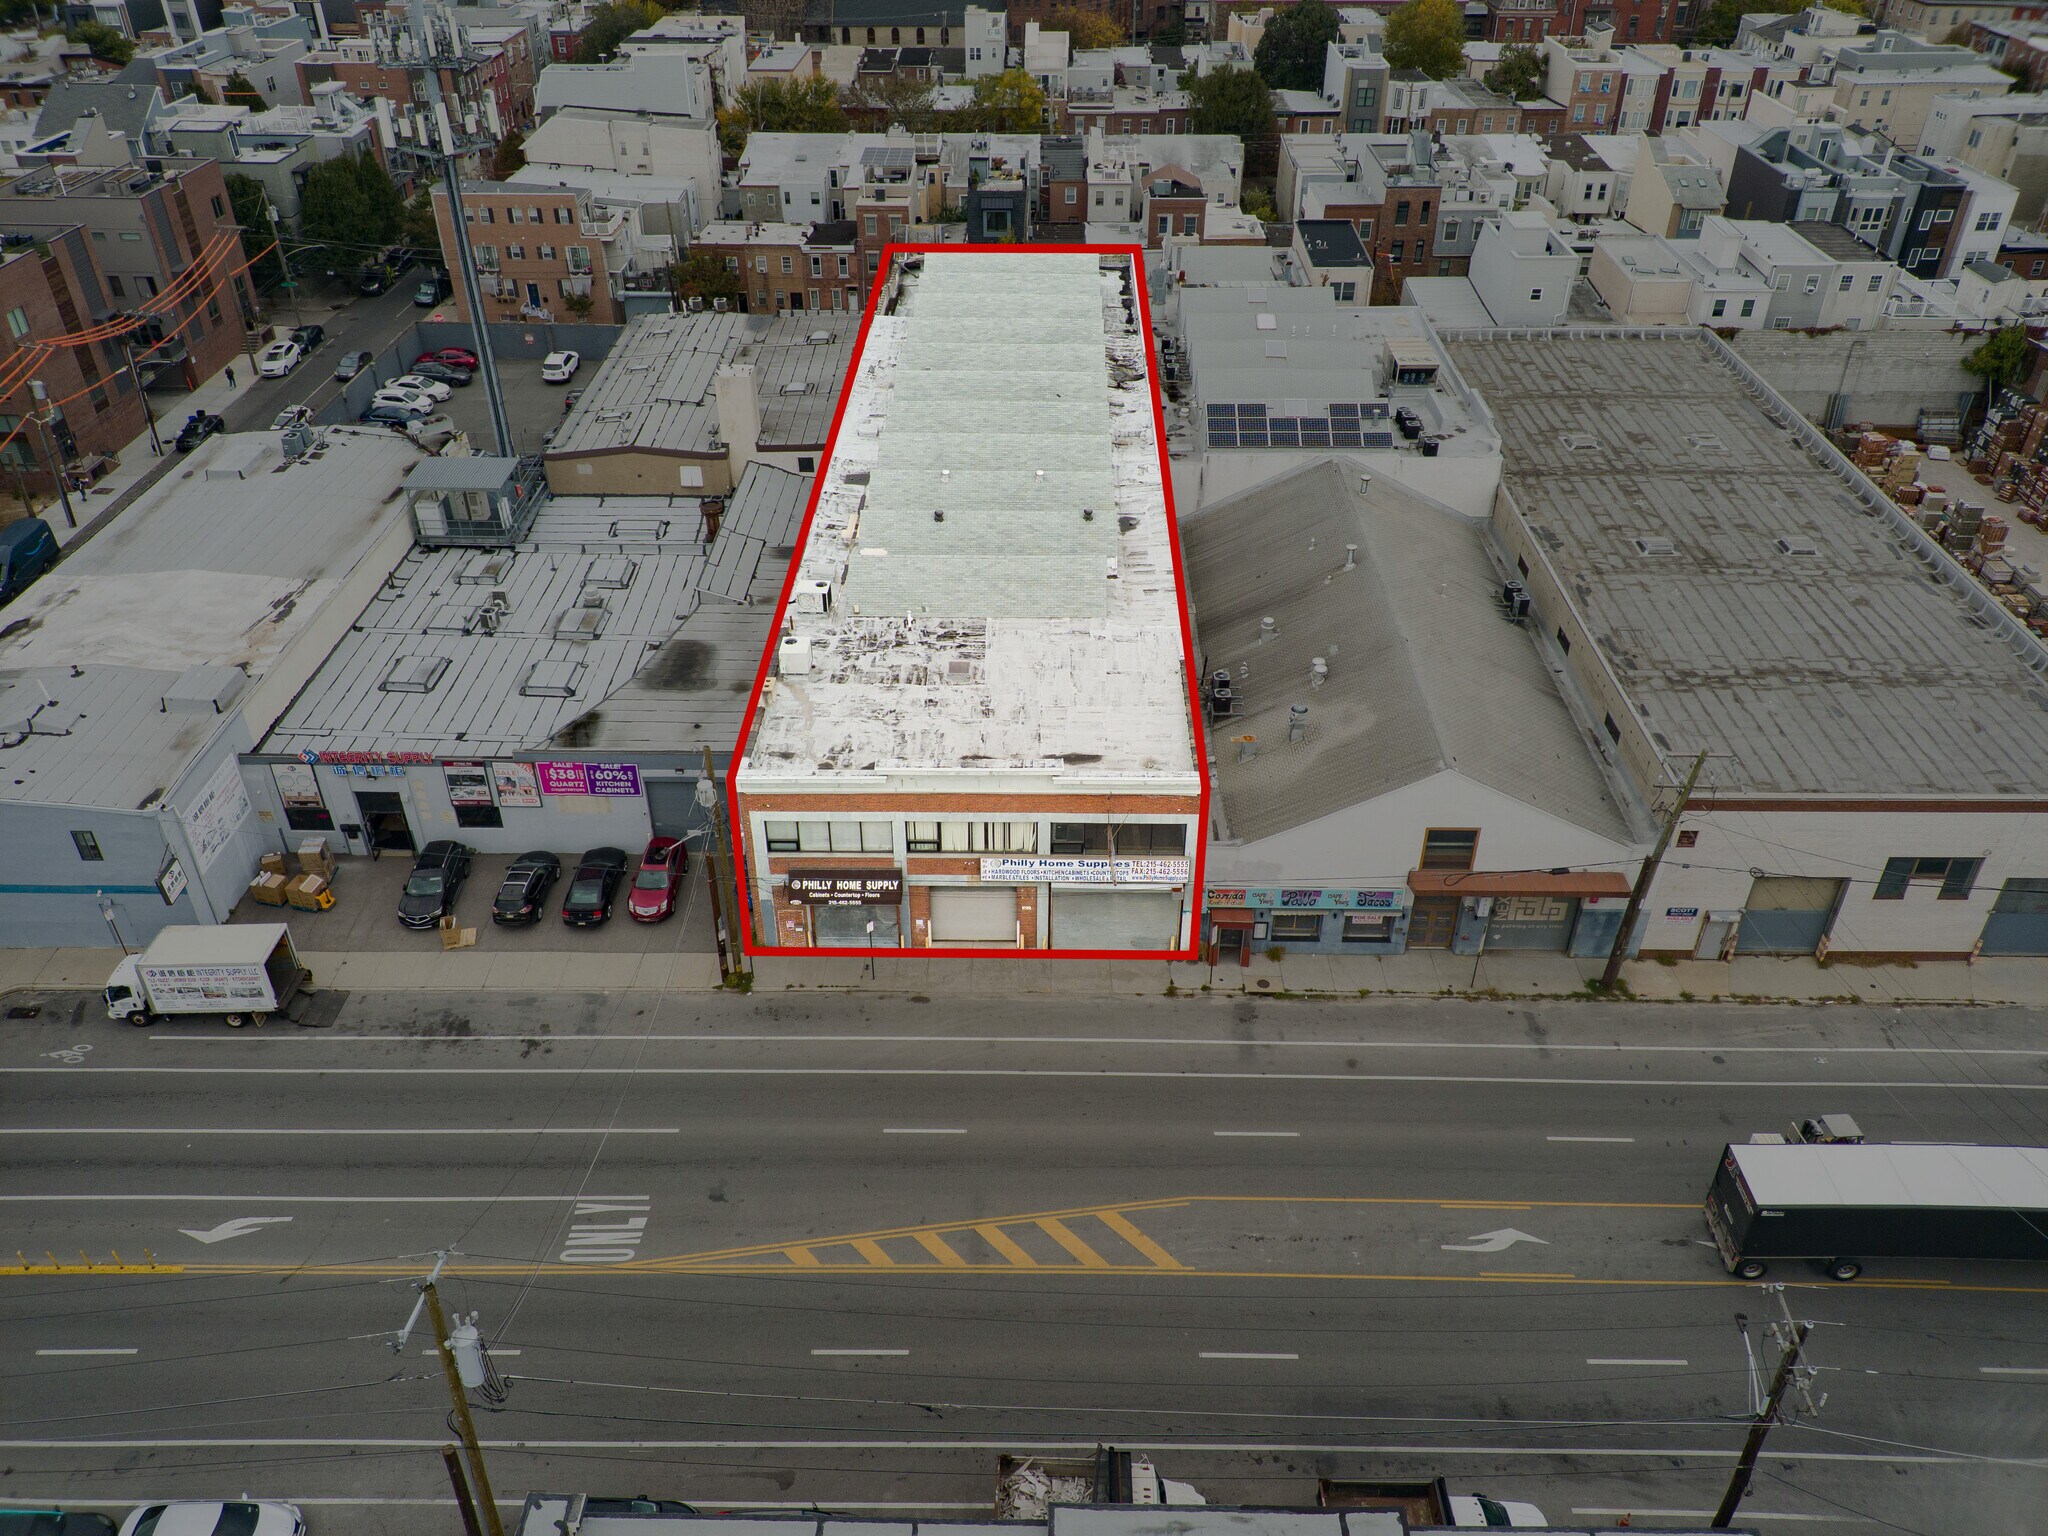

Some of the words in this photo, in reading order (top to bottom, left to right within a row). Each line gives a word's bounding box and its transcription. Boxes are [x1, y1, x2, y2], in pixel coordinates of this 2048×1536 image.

[319, 751, 383, 764] INTEGRITY
[387, 751, 433, 764] SUPPLY
[549, 768, 576, 780] $38
[595, 770, 628, 780] 60%
[596, 780, 632, 788] KITCHEN
[1002, 859, 1035, 868] Philly
[802, 880, 832, 890] PHILLY
[837, 880, 862, 890] HOME
[866, 880, 899, 890] SUPPLY
[1208, 890, 1245, 900] Comida
[1282, 891, 1316, 906] Pollo
[1357, 891, 1392, 907] Tacos
[196, 968, 224, 976] INTEGRITY
[226, 968, 246, 976] SUPPLY
[248, 968, 259, 976] LLC
[560, 1202, 651, 1262] ONLY
